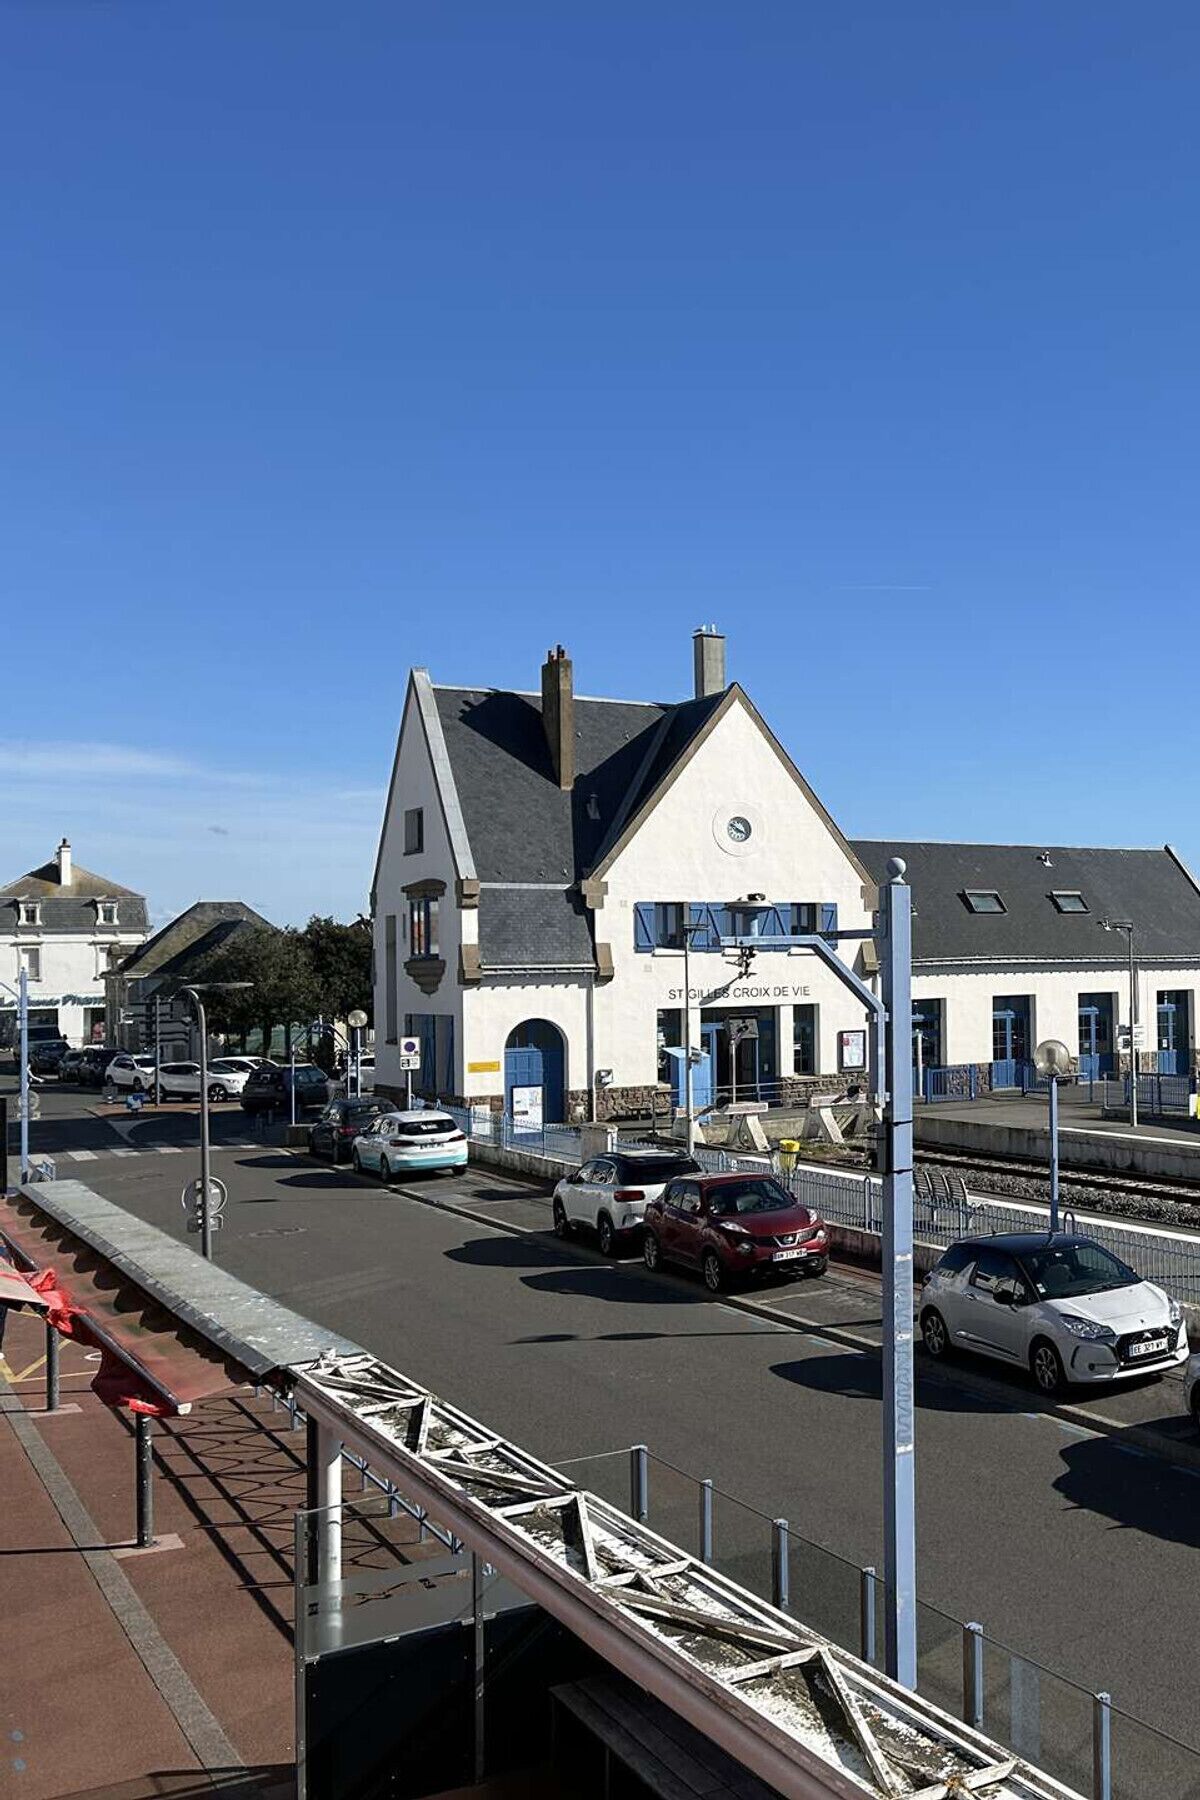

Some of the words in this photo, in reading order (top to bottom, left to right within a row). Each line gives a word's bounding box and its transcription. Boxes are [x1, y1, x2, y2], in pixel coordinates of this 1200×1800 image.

[668, 989, 684, 1000] ST
[688, 986, 730, 1000] GILLES
[732, 986, 770, 998] CROIX
[773, 986, 789, 997] DE
[792, 985, 811, 996] VIE
